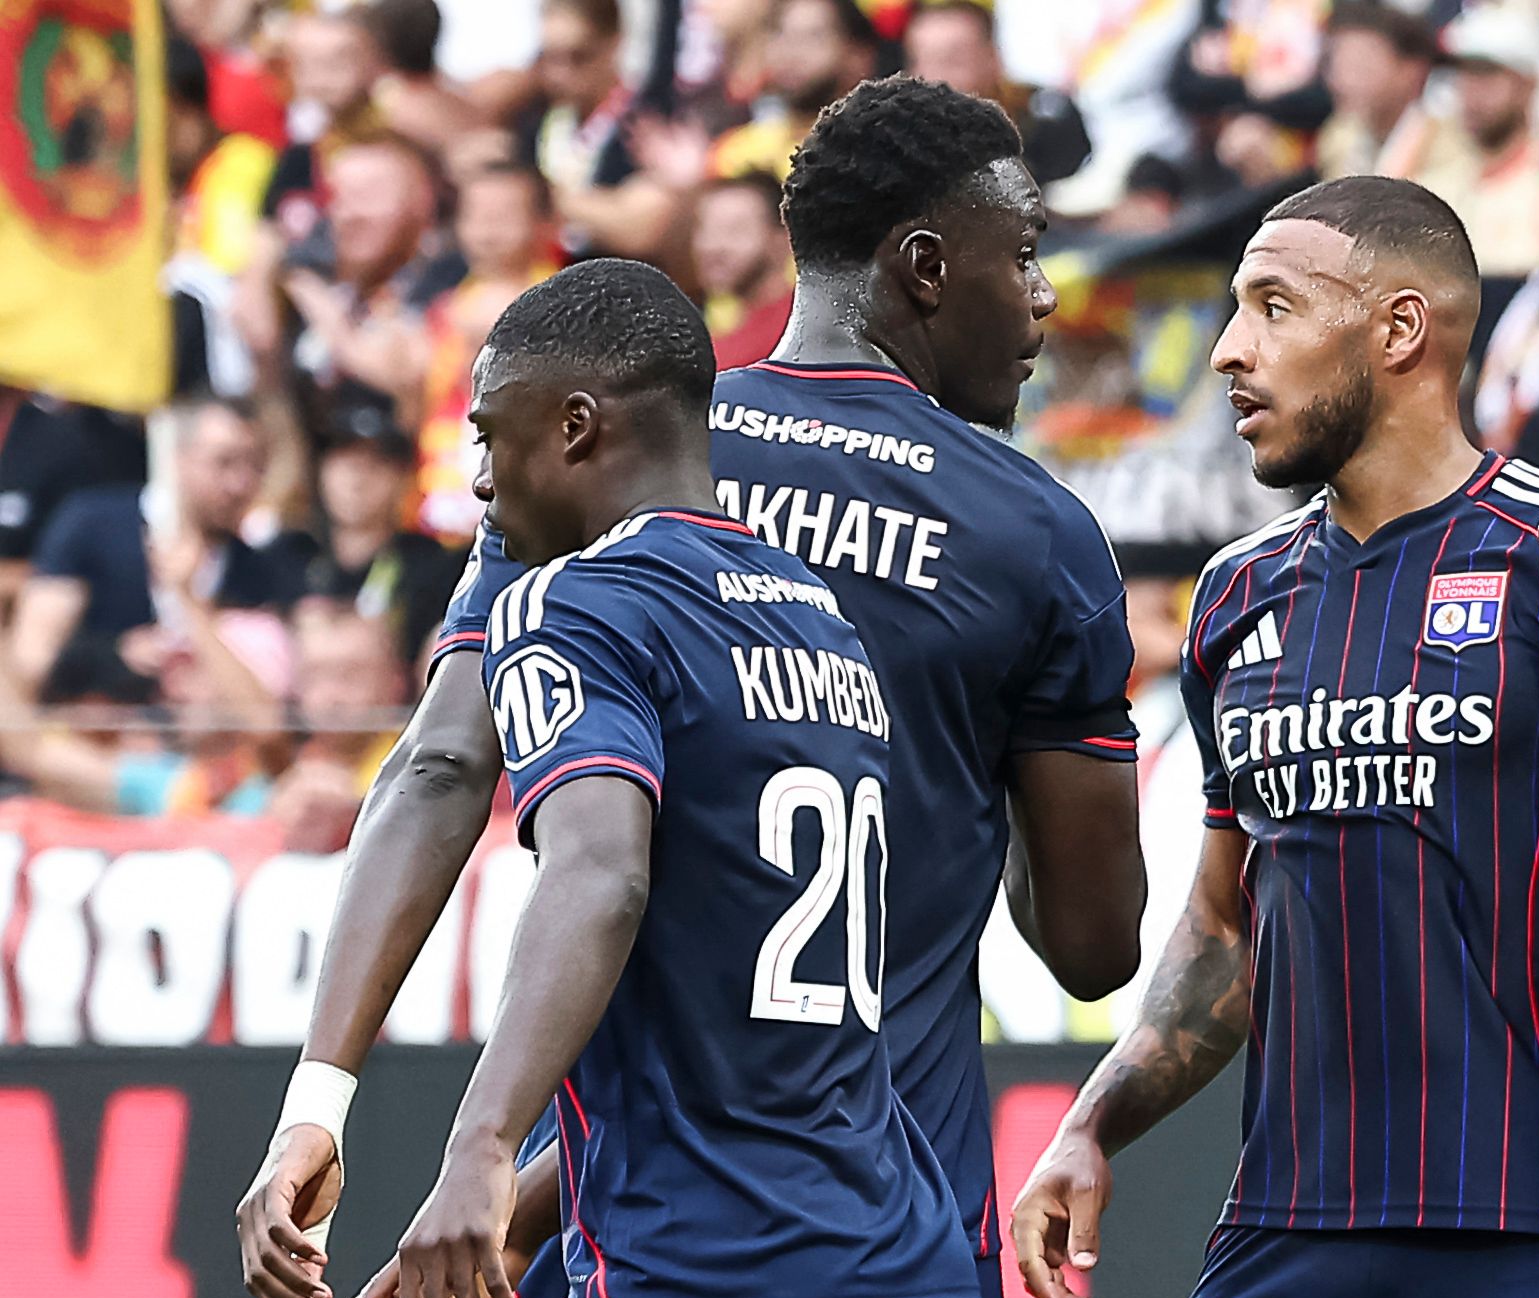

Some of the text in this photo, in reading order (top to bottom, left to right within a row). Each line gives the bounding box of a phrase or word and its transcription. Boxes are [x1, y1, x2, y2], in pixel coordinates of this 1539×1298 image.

[1436, 587, 1497, 598] LYONNAIS
[1437, 577, 1499, 589] OLYMPIQUE
[1433, 601, 1490, 635] OL
[1220, 684, 1494, 772] Emirates
[1254, 755, 1436, 818] FLY BETTER
[750, 766, 888, 1033] 20
